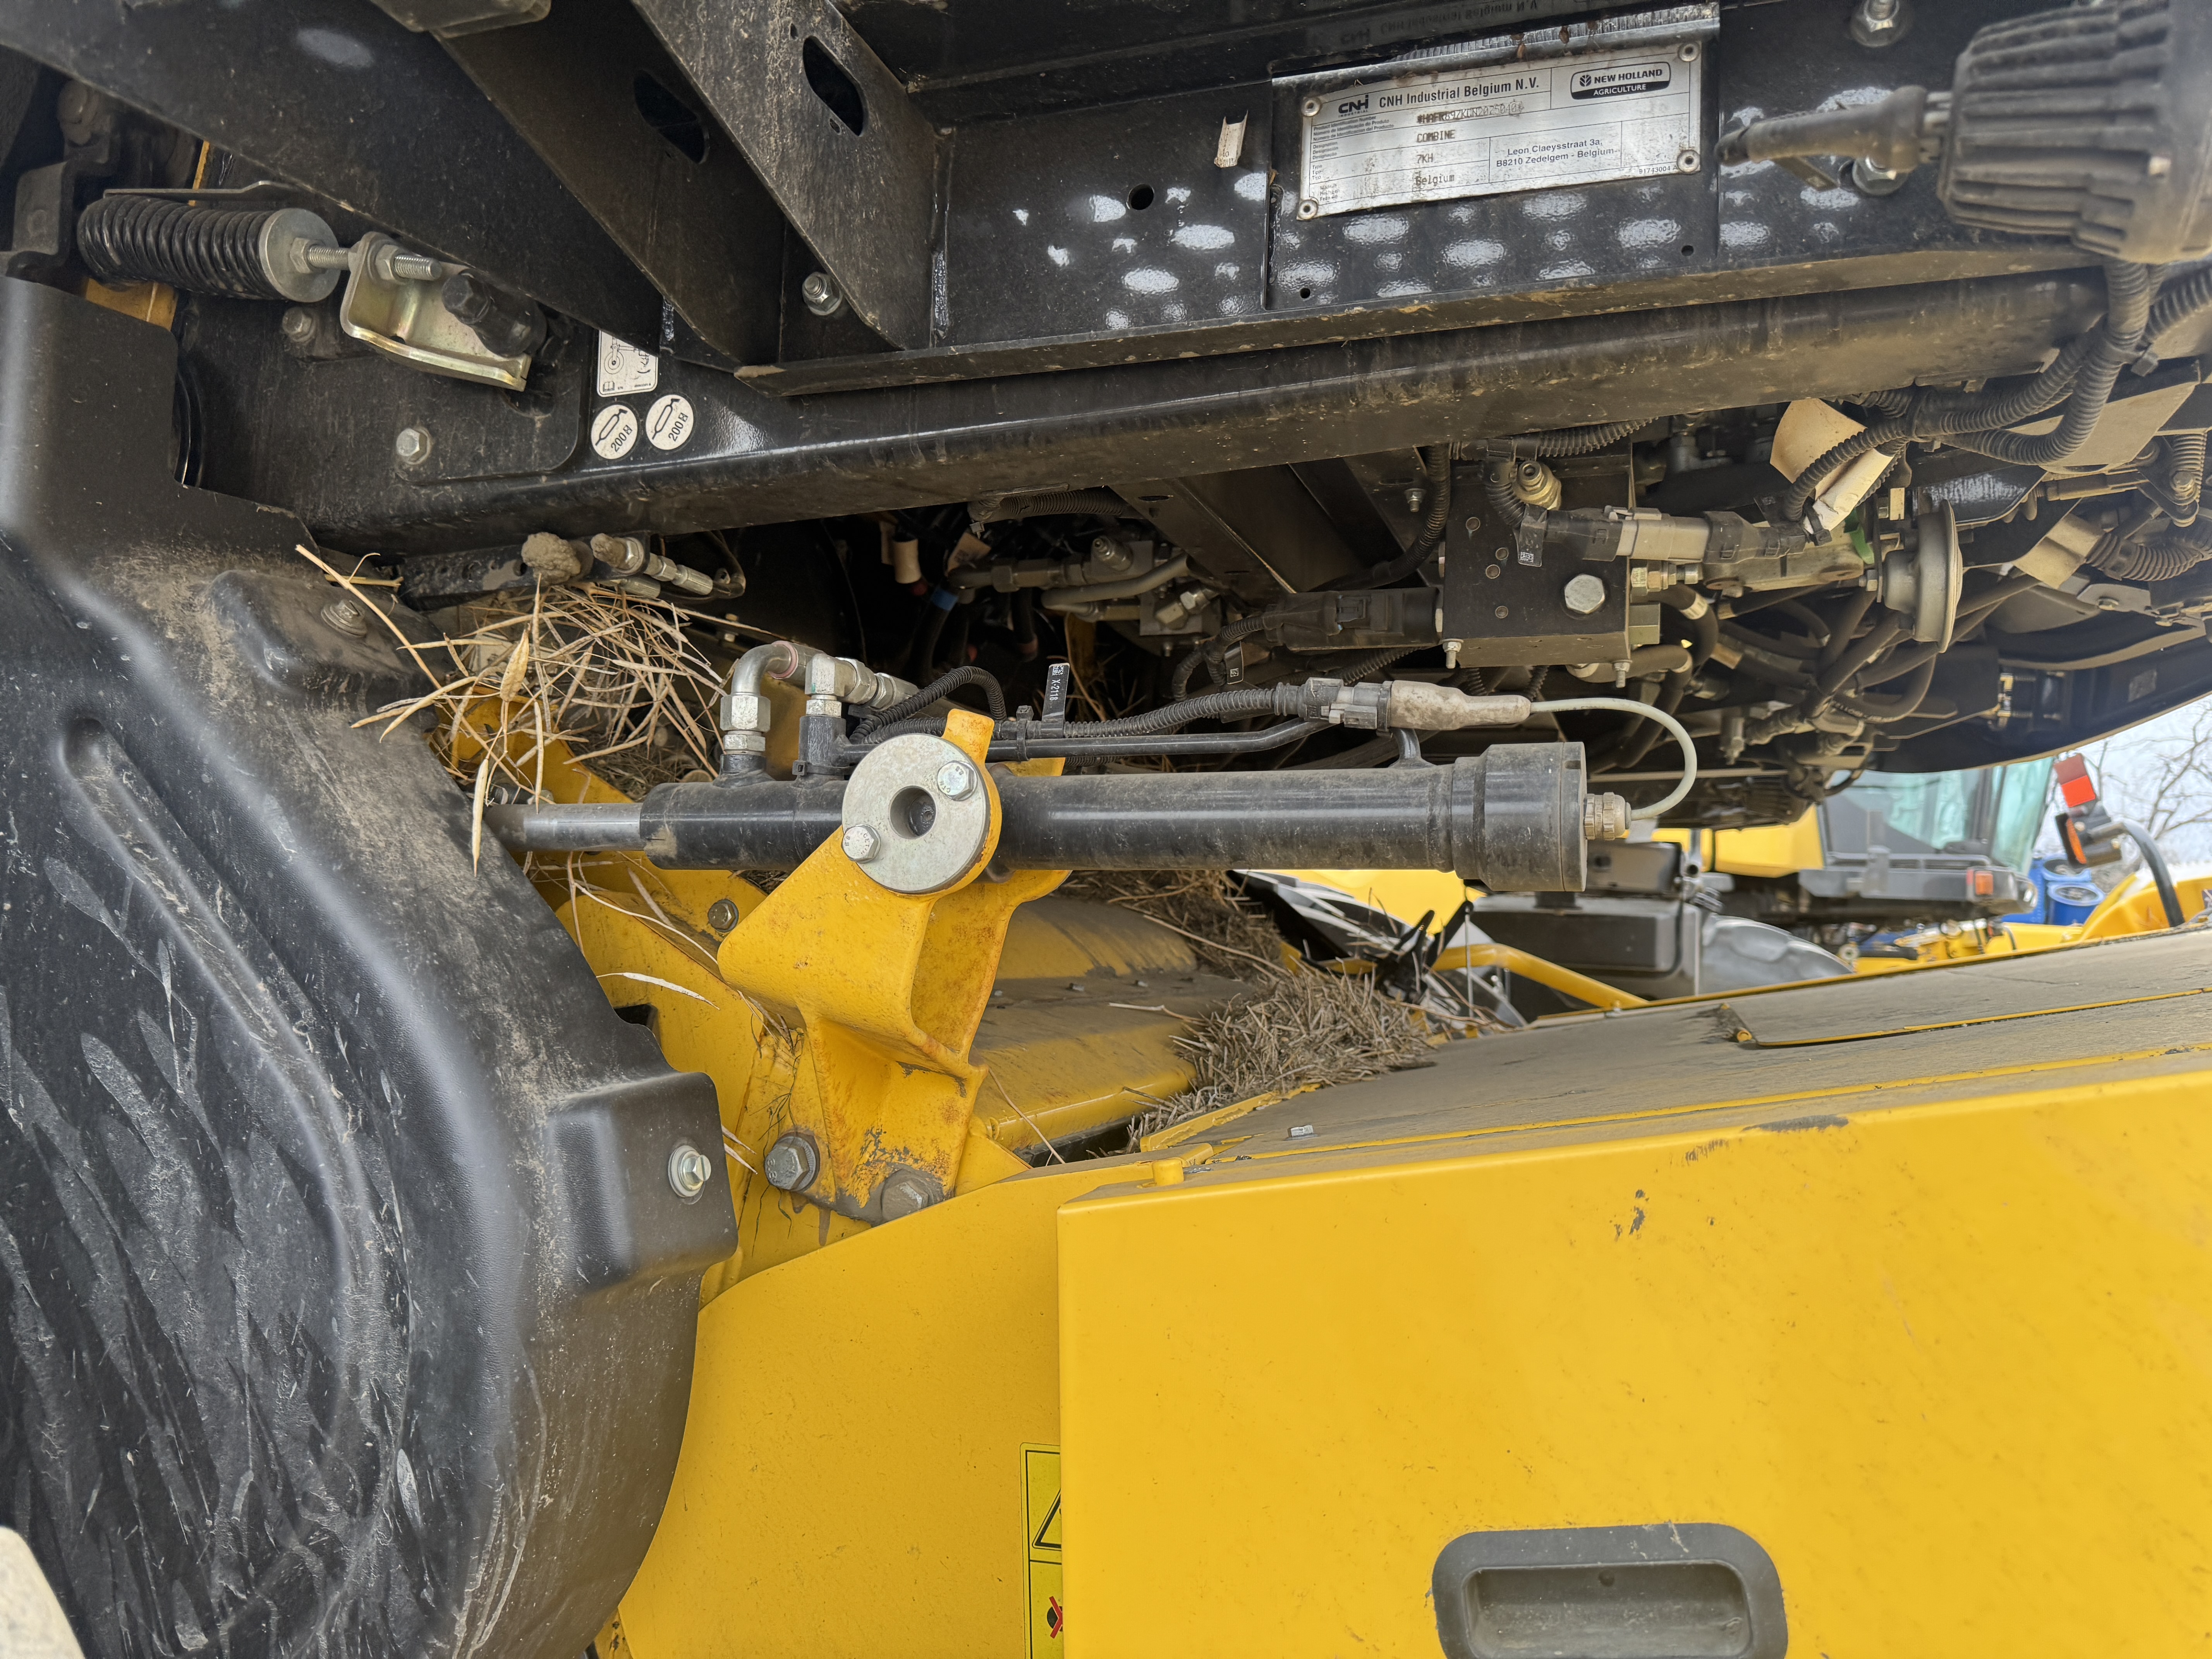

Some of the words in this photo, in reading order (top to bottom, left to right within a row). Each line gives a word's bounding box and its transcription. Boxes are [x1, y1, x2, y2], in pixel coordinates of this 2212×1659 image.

[1594, 75, 1616, 84] NEW
[1618, 69, 1662, 81] HOLLAND
[1379, 94, 1402, 108] CNH
[1407, 87, 1460, 104] Industrial
[1464, 82, 1511, 97] Belgium
[1516, 77, 1539, 90] N.V.
[1593, 84, 1646, 96] AGRICULTURE
[1338, 110, 1368, 118] INDUSTRIAL
[1417, 129, 1456, 143] COMBINE
[1508, 148, 1529, 156] Leon
[1532, 140, 1587, 153] Claeysstraat
[1417, 153, 1433, 164] 7KH
[1497, 157, 1523, 167] B8210
[1525, 154, 1568, 164] Zedelgem
[1577, 148, 1614, 158] Belgium
[1415, 173, 1455, 187] Belgium
[668, 421, 684, 442] 200
[611, 432, 627, 452] 200
